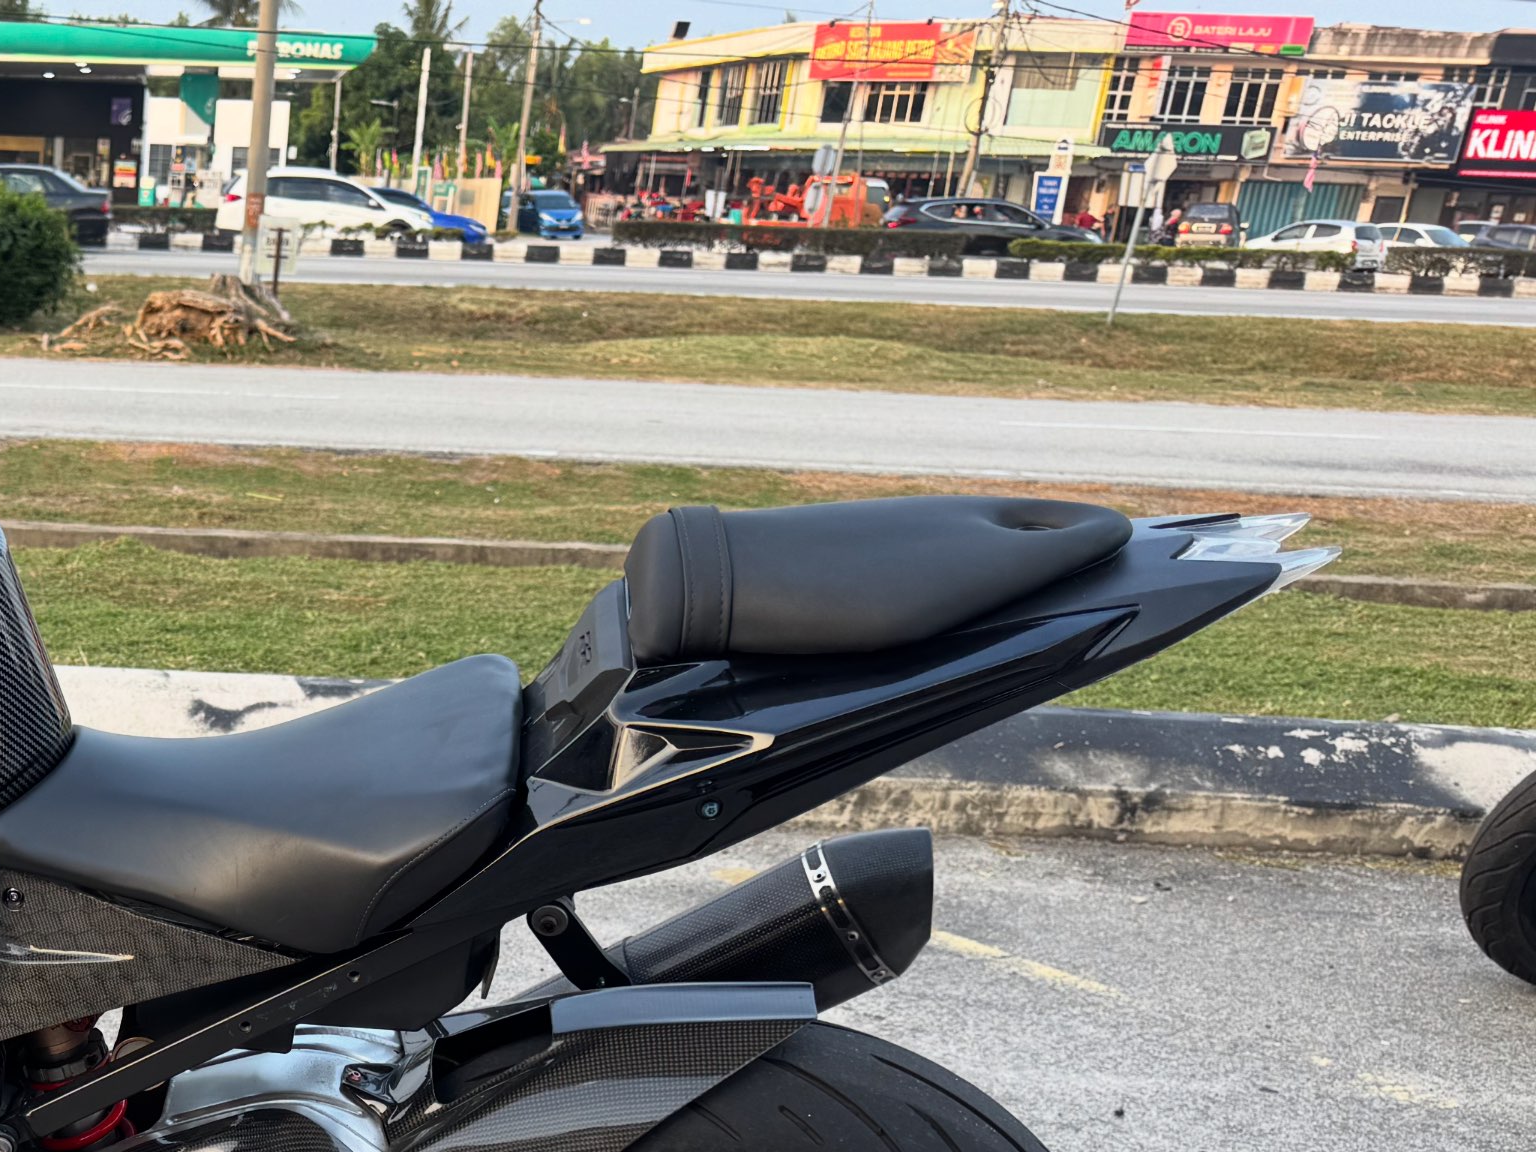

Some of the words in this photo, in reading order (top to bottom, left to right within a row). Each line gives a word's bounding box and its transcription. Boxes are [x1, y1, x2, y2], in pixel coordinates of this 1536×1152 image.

[1193, 26, 1237, 37] BATERI
[1238, 28, 1272, 38] LAJU
[246, 40, 344, 59] PRONAS
